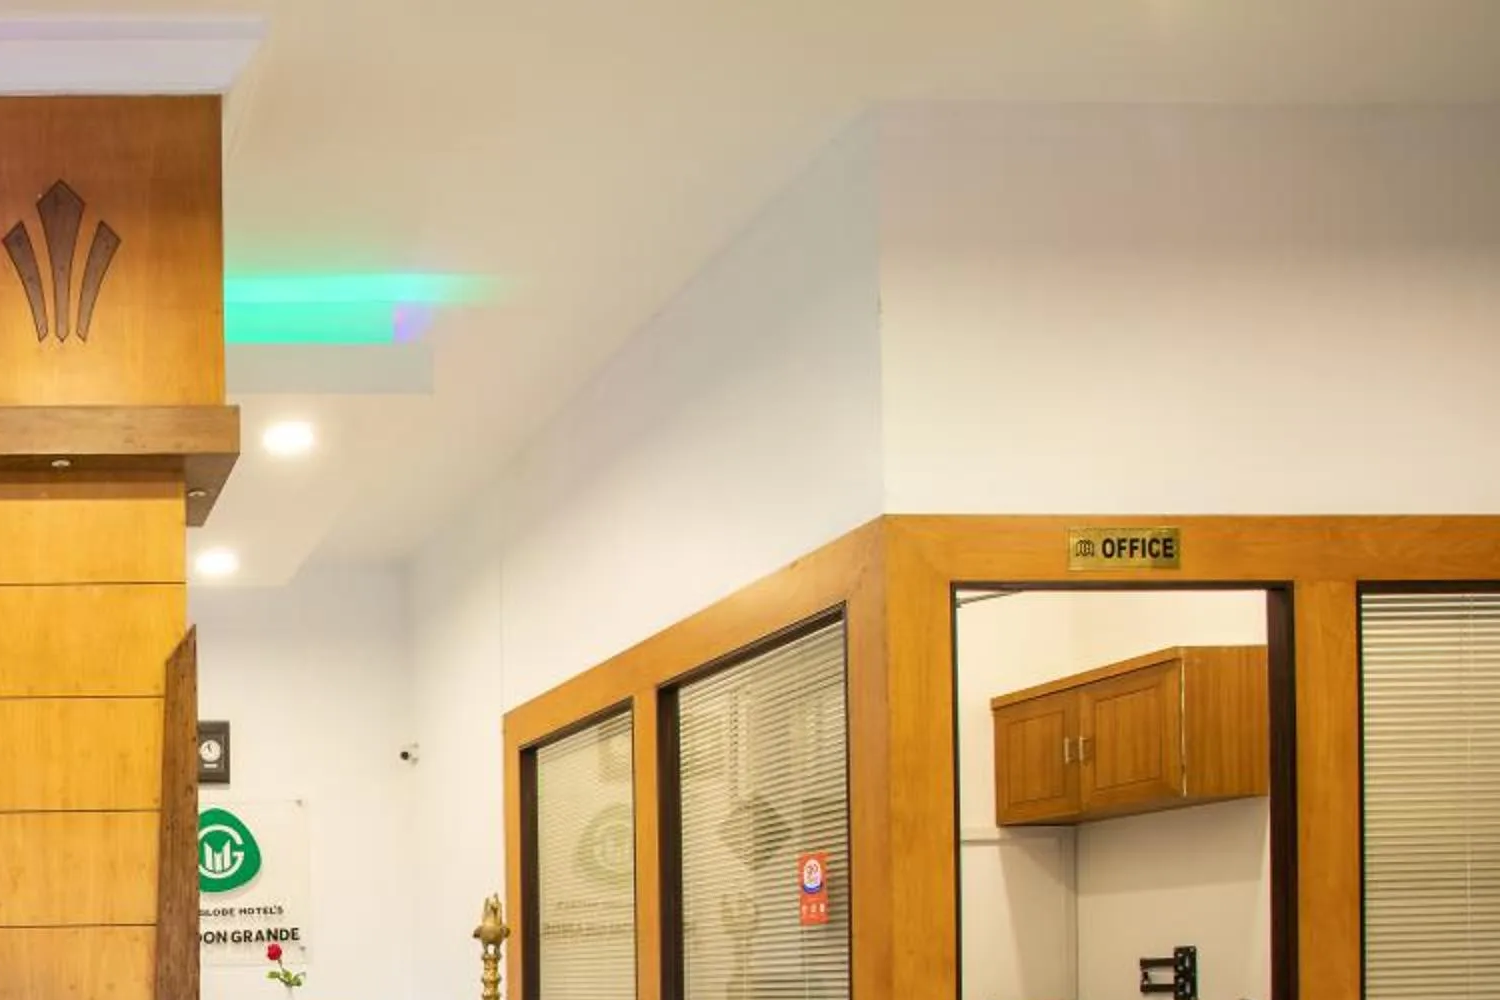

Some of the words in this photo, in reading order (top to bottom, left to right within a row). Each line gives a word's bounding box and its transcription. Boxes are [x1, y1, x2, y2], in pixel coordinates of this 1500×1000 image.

[1102, 538, 1175, 558] OFFICE
[199, 929, 227, 944] ON
[231, 927, 300, 943] GRANDE
